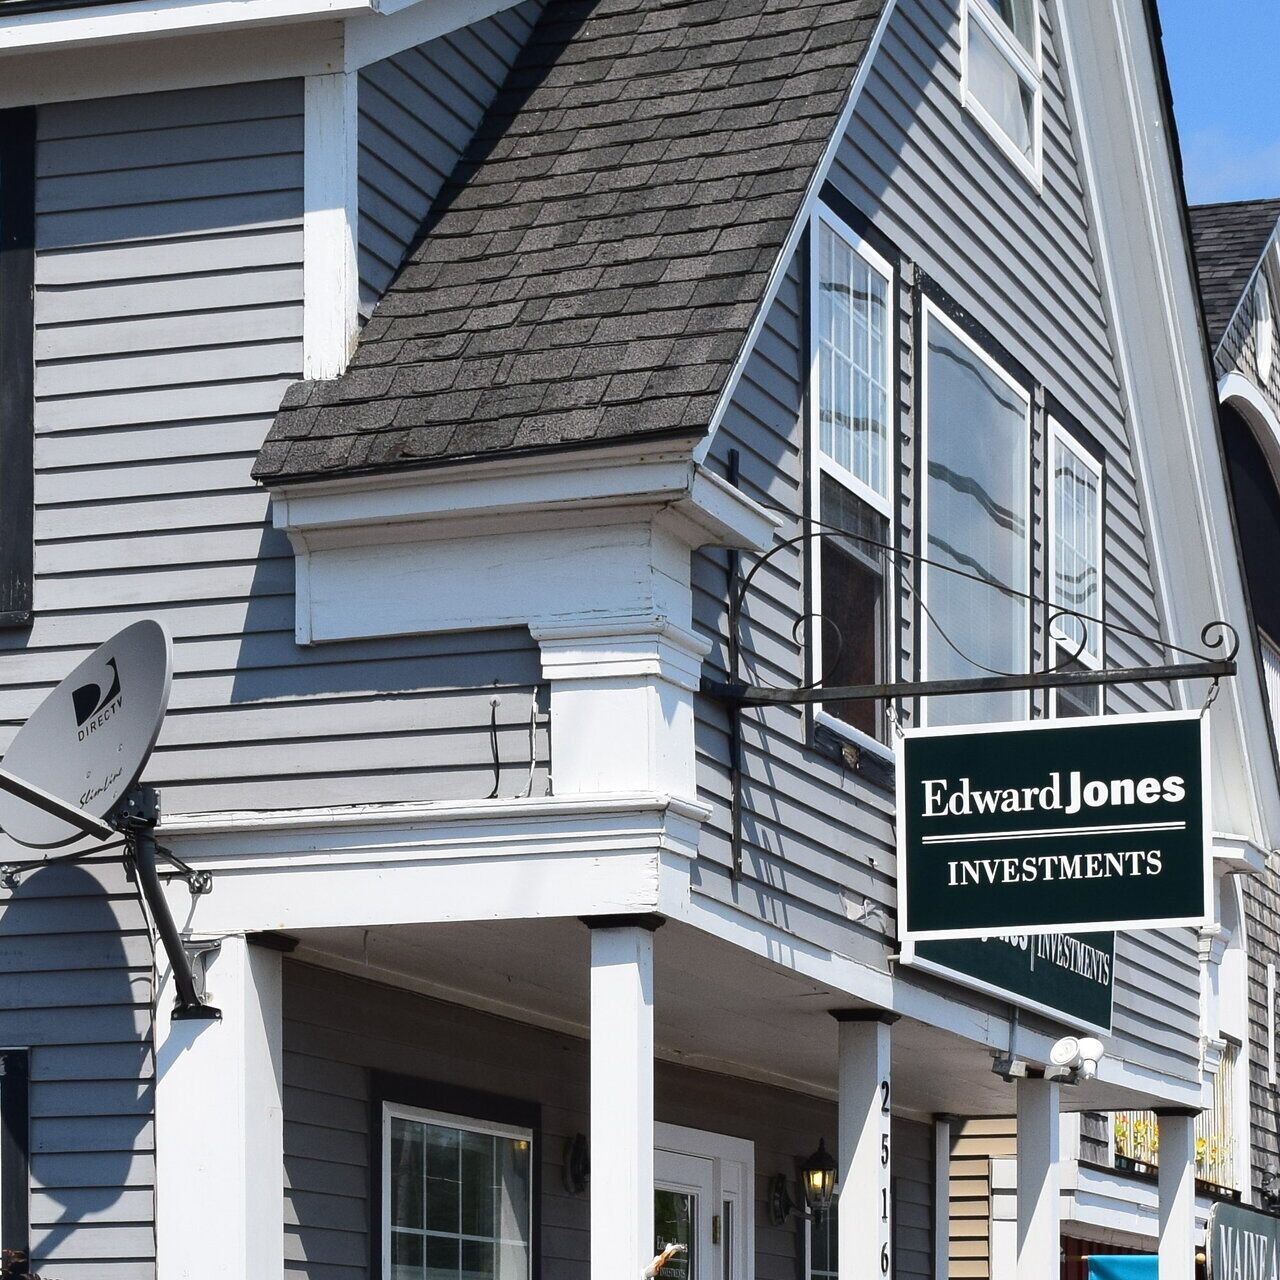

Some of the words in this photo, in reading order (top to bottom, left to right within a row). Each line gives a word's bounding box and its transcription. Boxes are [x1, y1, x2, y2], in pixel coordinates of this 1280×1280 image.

[77, 695, 123, 742] DIRECTV
[948, 849, 1163, 886] INVESTMENTS
[1037, 933, 1111, 986] INVESTMENTS
